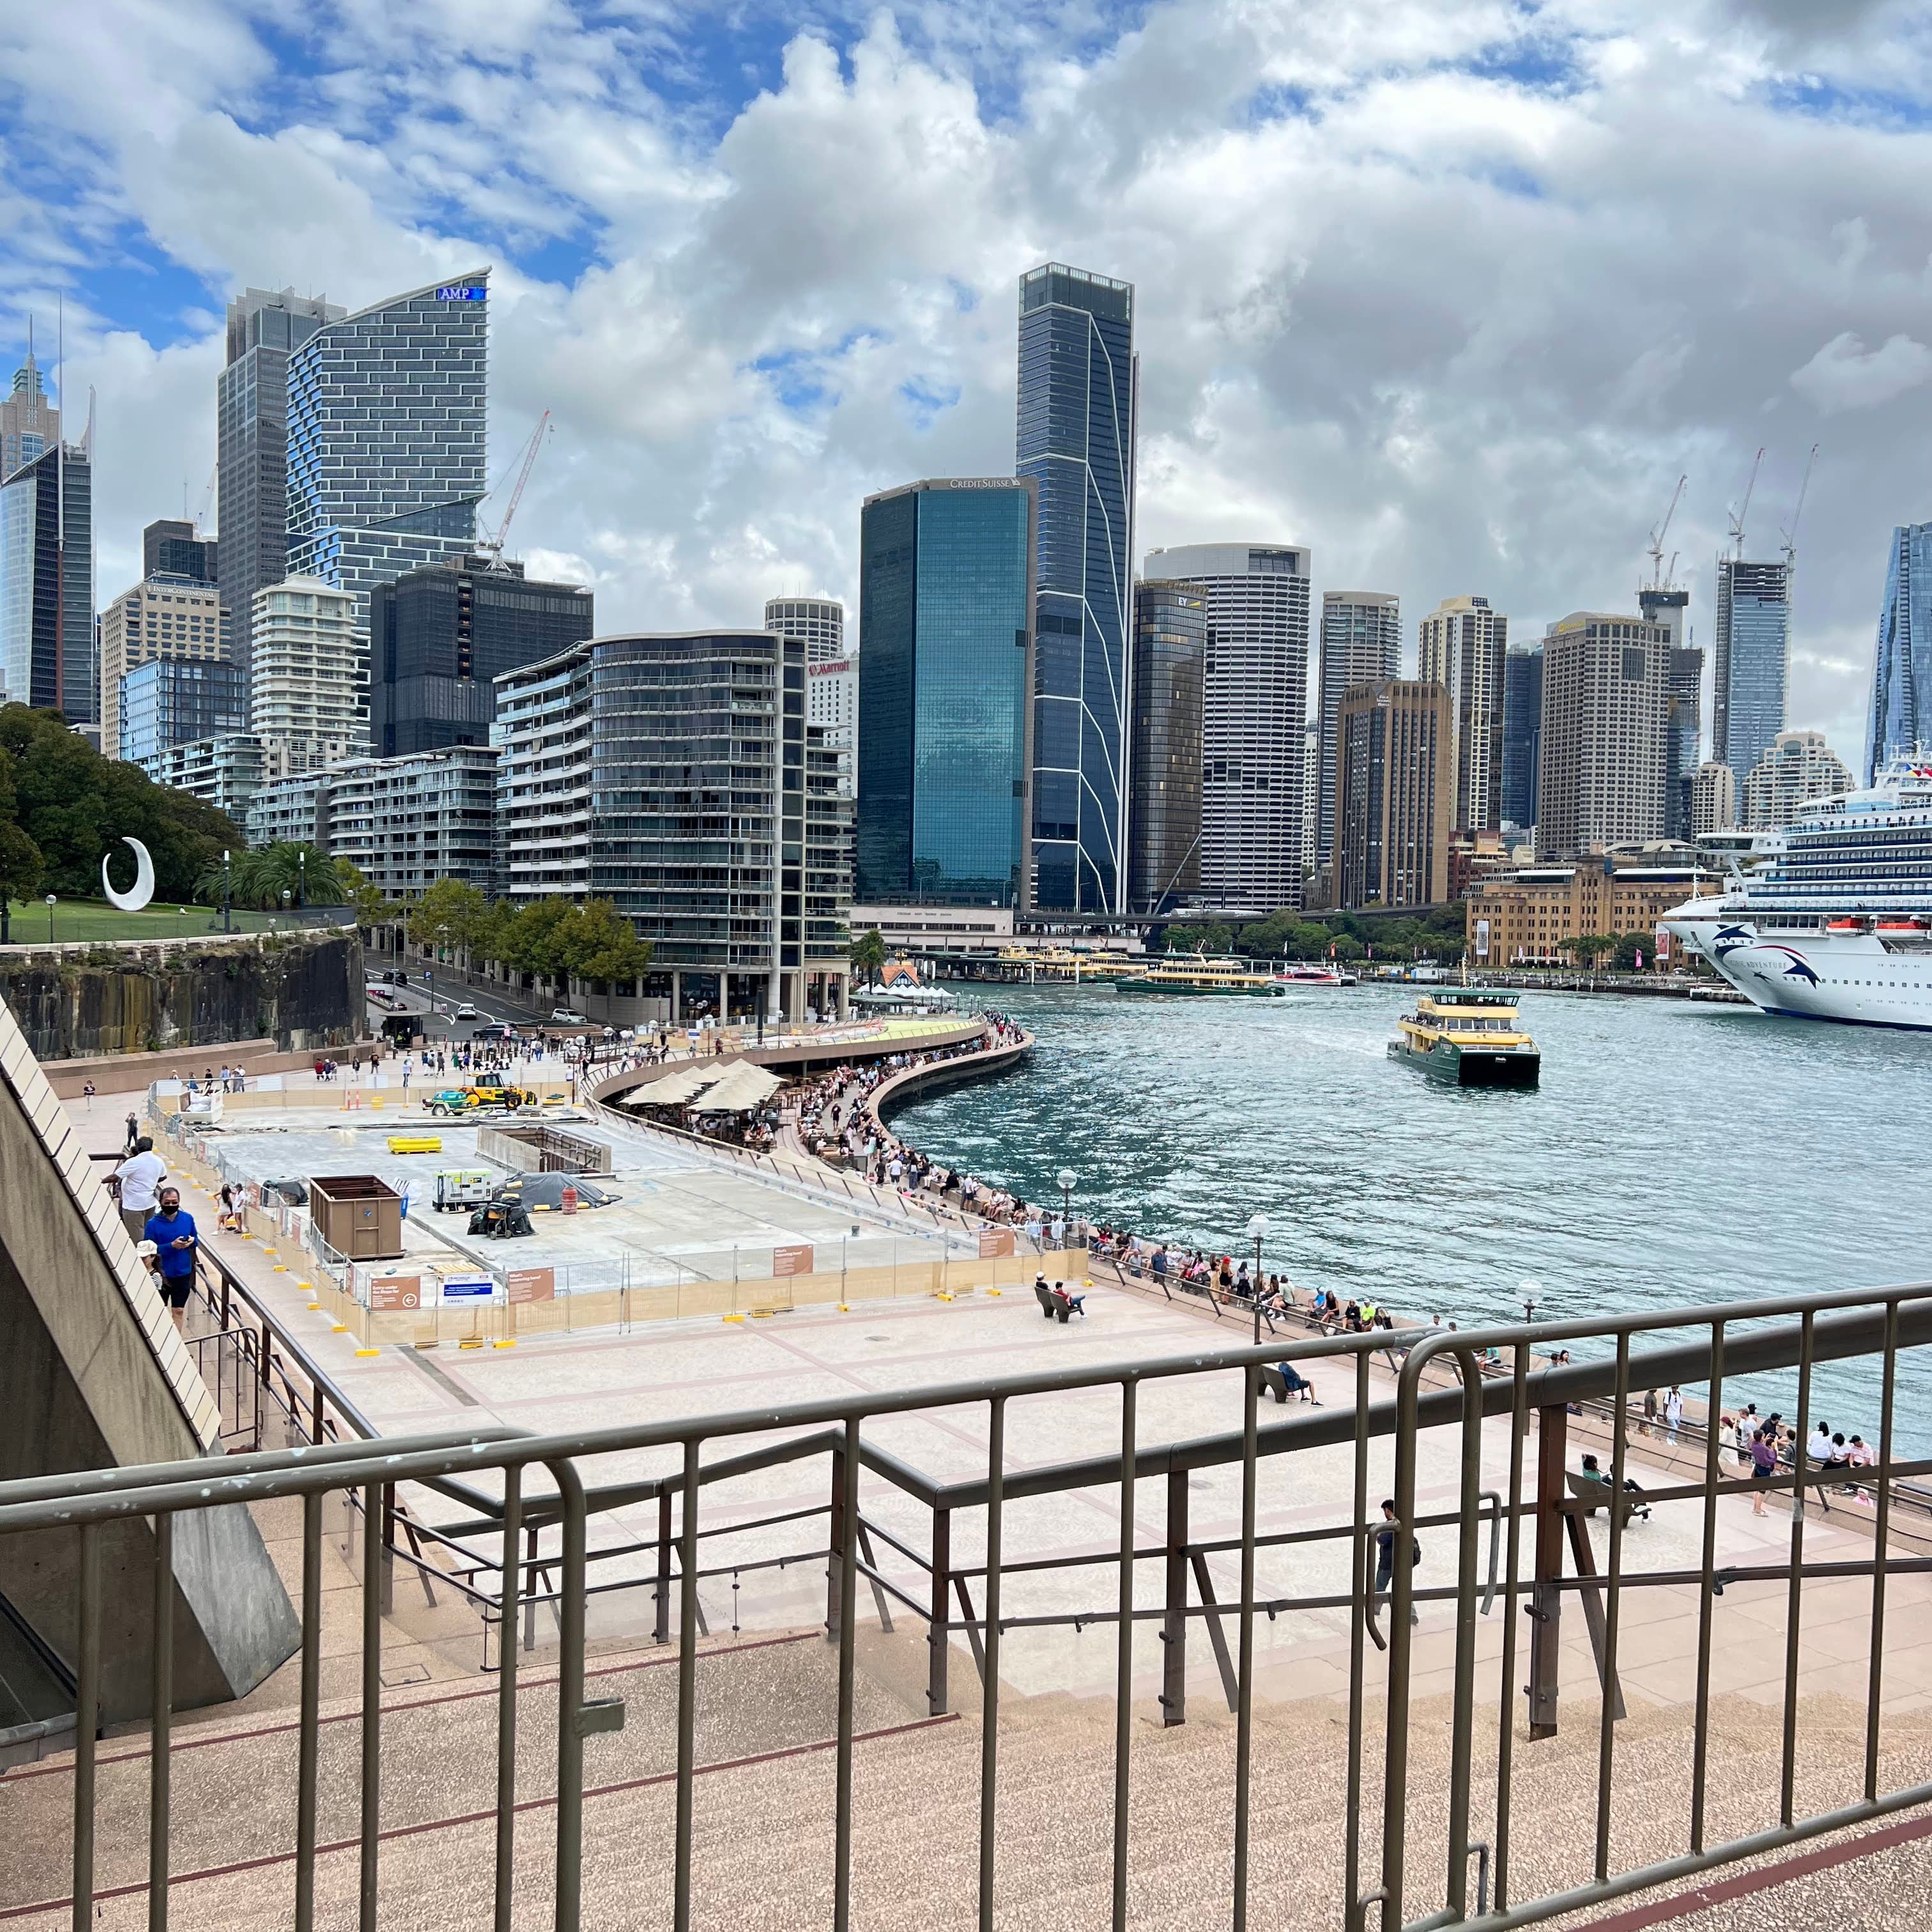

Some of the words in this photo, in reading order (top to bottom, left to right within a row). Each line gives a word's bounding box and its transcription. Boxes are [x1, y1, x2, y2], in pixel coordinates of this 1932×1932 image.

[441, 288, 469, 300] AMP
[950, 479, 982, 488] CREDIT
[983, 479, 1009, 487] SUISSE
[1178, 597, 1188, 606] EY
[817, 659, 850, 676] Marriott
[1747, 960, 1787, 969] ADVENTURE
